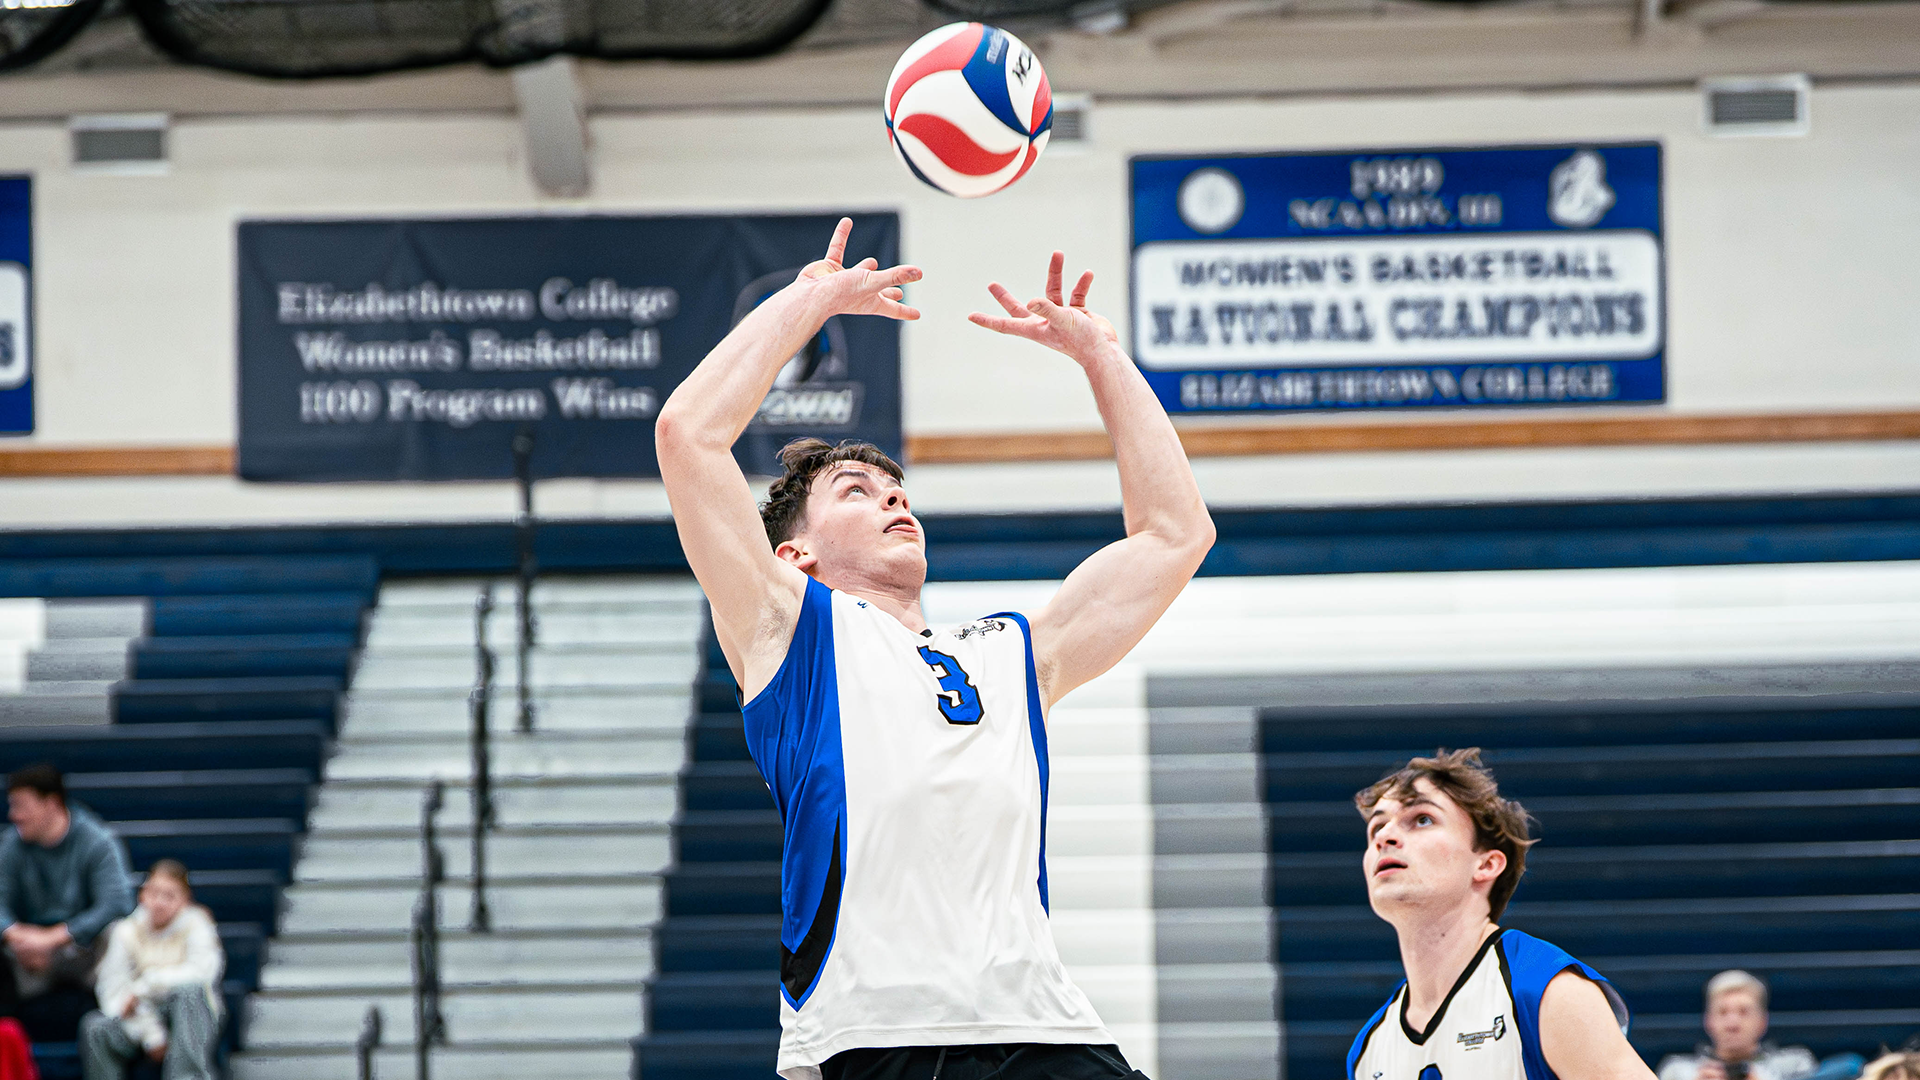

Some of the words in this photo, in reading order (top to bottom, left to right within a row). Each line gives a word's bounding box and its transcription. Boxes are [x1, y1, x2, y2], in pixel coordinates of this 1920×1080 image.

[1177, 257, 1356, 286] WOMEN'S
[1370, 249, 1616, 281] BASKETBALL
[278, 280, 533, 322] Elizabethtown
[539, 277, 678, 323] College
[1150, 302, 1373, 346] NATIONAL
[1388, 293, 1646, 341] CHAMPIONS
[296, 331, 462, 370] Women's
[469, 330, 661, 370] Basketball
[386, 382, 545, 425] Program
[553, 376, 658, 418] Wins
[757, 389, 854, 425] OWN
[1181, 369, 1459, 407] ELIZABETHTOWN
[1460, 364, 1613, 399] COLLEGE
[916, 645, 985, 725] 3
